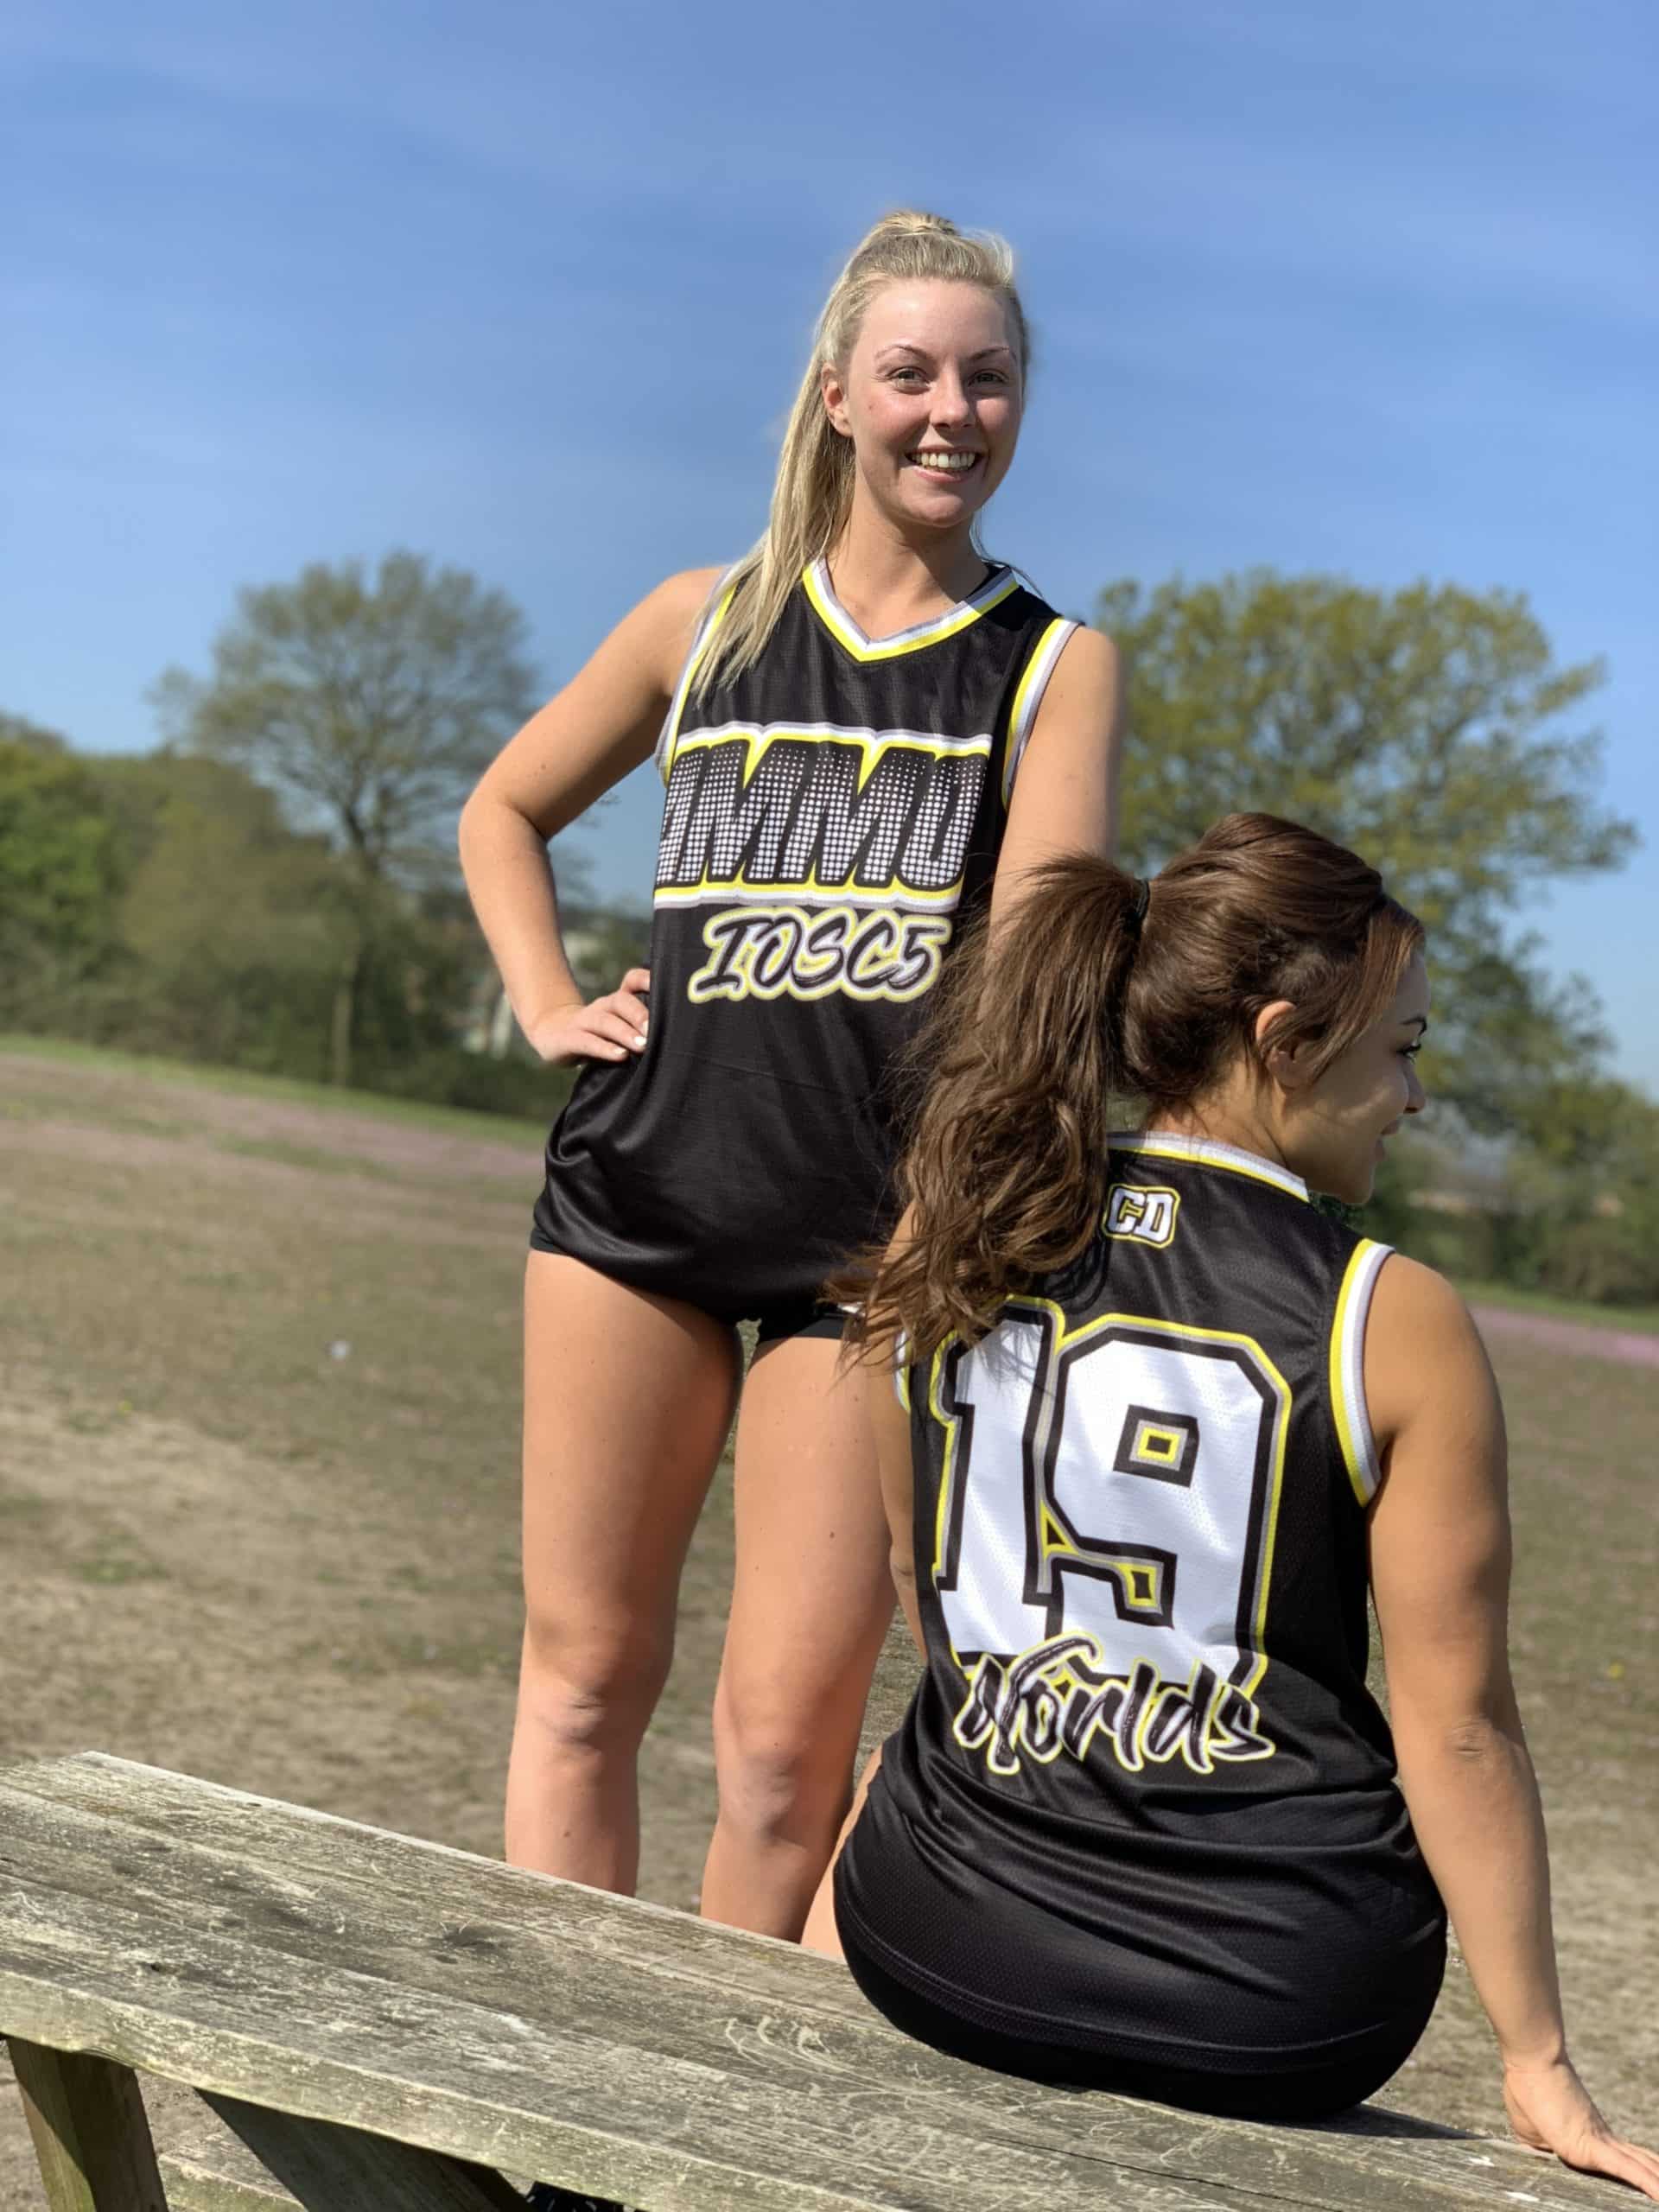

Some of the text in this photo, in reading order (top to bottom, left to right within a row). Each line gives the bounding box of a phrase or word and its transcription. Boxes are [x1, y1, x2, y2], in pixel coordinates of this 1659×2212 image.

[1103, 1185, 1179, 1247] CD
[931, 1296, 1290, 1695] 19
[954, 1631, 1274, 1772] Worlds
